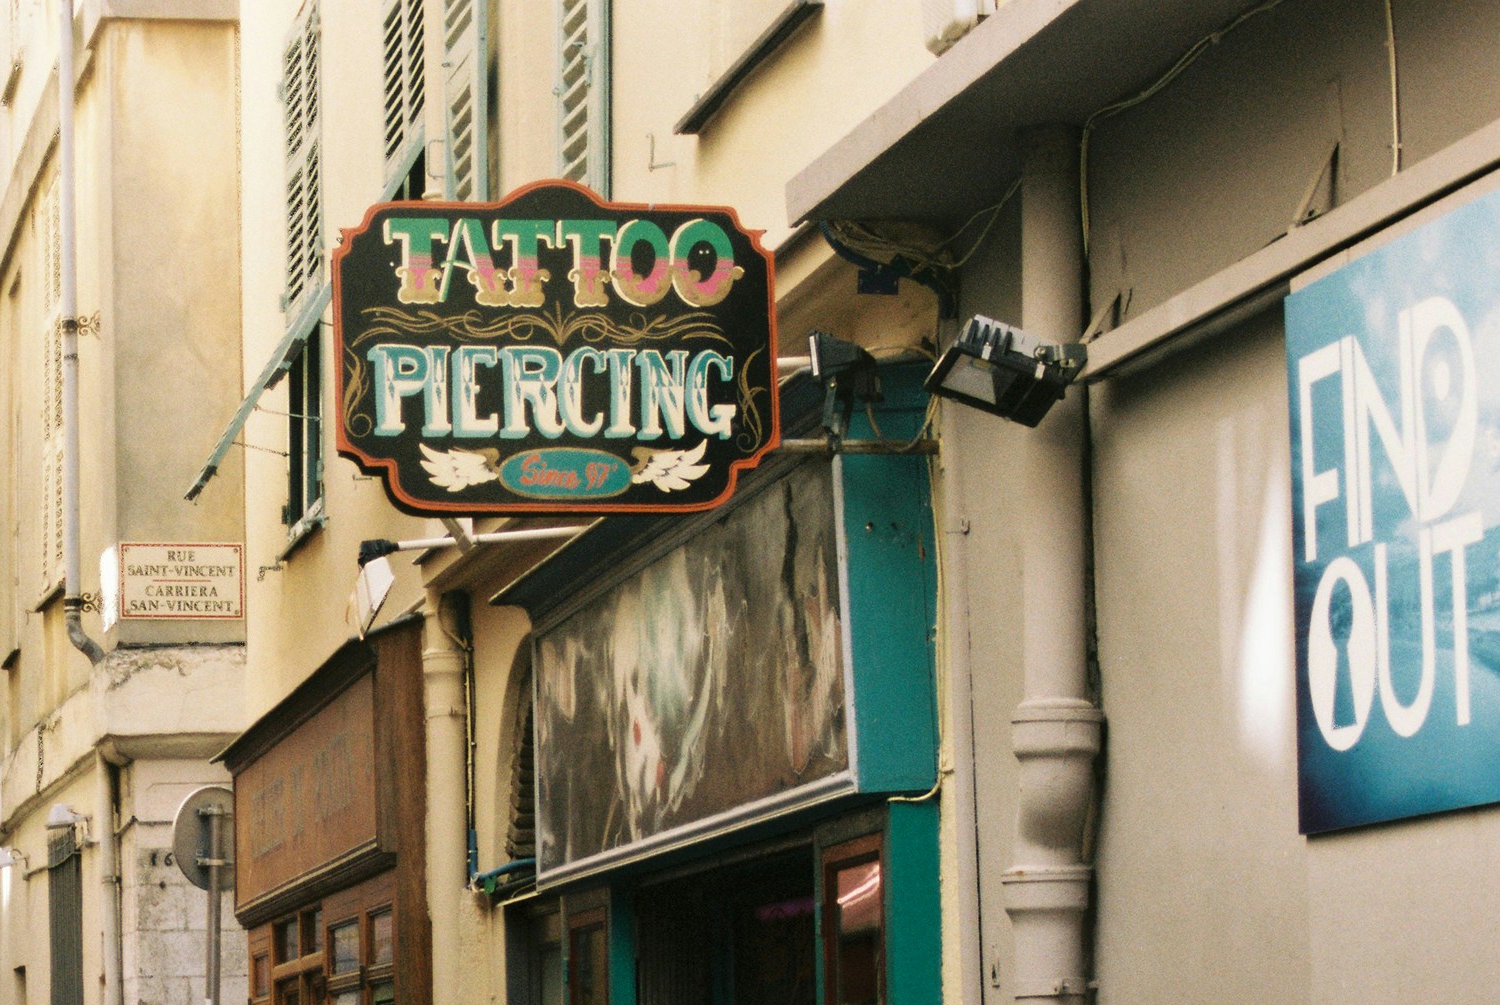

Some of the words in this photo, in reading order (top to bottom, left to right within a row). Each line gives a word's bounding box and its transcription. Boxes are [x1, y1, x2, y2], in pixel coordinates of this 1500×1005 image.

[383, 218, 744, 307] TATTOO
[367, 344, 736, 440] PIERCING
[1299, 295, 1478, 563] FIND
[520, 454, 581, 489] Since
[128, 565, 235, 577] SAINT-VINCENT
[167, 551, 195, 562] RUE
[130, 600, 233, 612] SAN-VINCENT
[145, 585, 218, 597] CARRIERA
[1308, 511, 1484, 751] OUT
